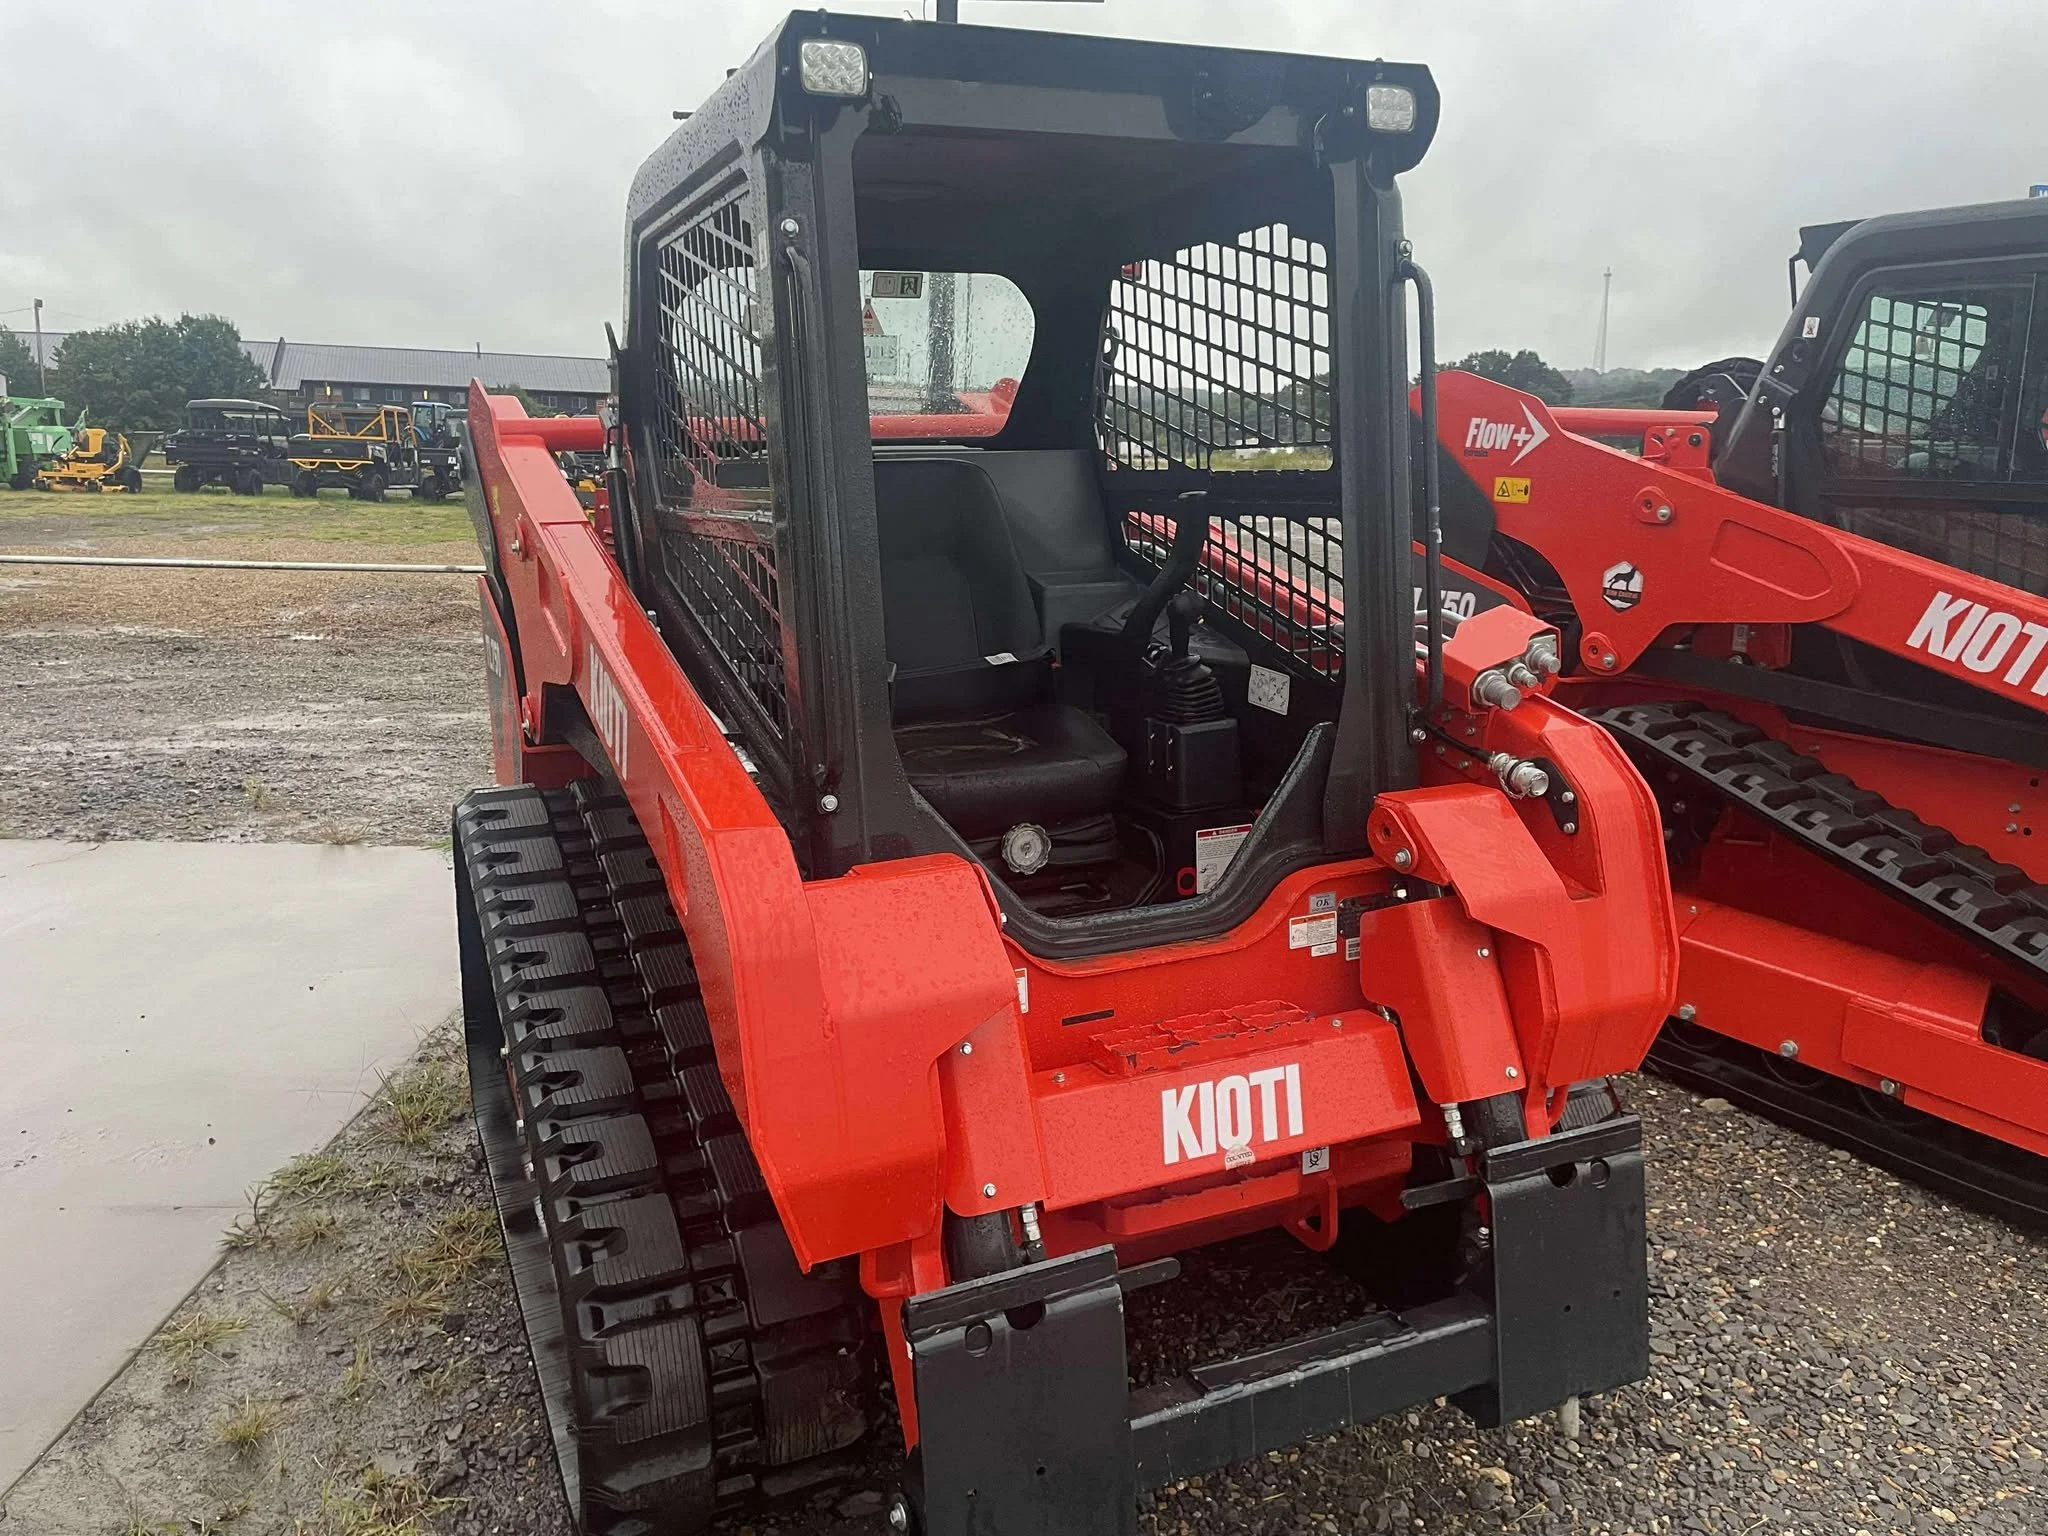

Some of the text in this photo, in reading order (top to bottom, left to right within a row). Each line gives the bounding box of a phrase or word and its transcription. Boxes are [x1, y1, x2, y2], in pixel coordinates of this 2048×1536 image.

[1465, 417, 1532, 450] Flow+
[589, 643, 629, 782] KIOTI
[1161, 1063, 1304, 1166] KIOTI
